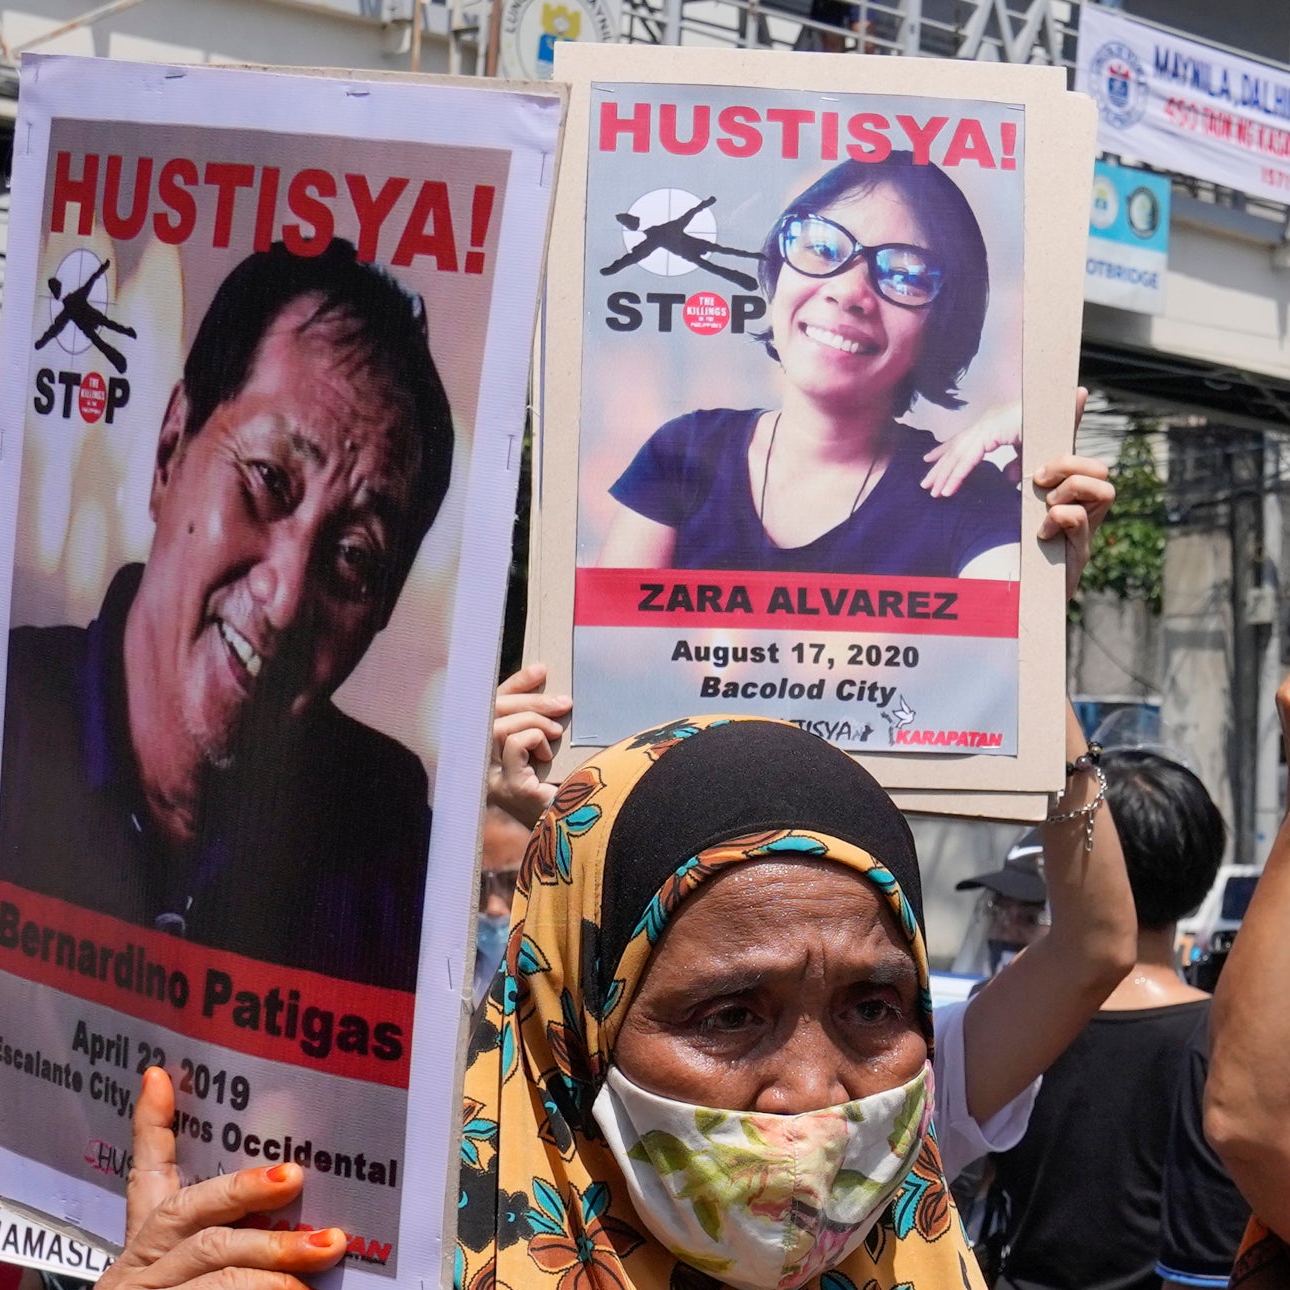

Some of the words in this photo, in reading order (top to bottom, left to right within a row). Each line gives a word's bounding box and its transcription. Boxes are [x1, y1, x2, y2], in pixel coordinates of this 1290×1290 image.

[598, 101, 1018, 171] HUSTISYA!
[49, 150, 496, 275] HUSTISYA!
[637, 582, 754, 614] ZARA
[766, 584, 959, 622] ALVAREZ
[671, 639, 781, 669] August
[790, 643, 836, 671] 17,
[847, 643, 921, 669] 2020
[699, 675, 826, 701] Bacolod
[835, 679, 898, 709] City
[895, 729, 1004, 747] KARAPATAN
[202, 967, 405, 1062] Patigas
[72, 1020, 130, 1069] April
[179, 1057, 251, 1112] 2019
[90, 1070, 134, 1120] City,
[221, 1122, 399, 1188] Occidental
